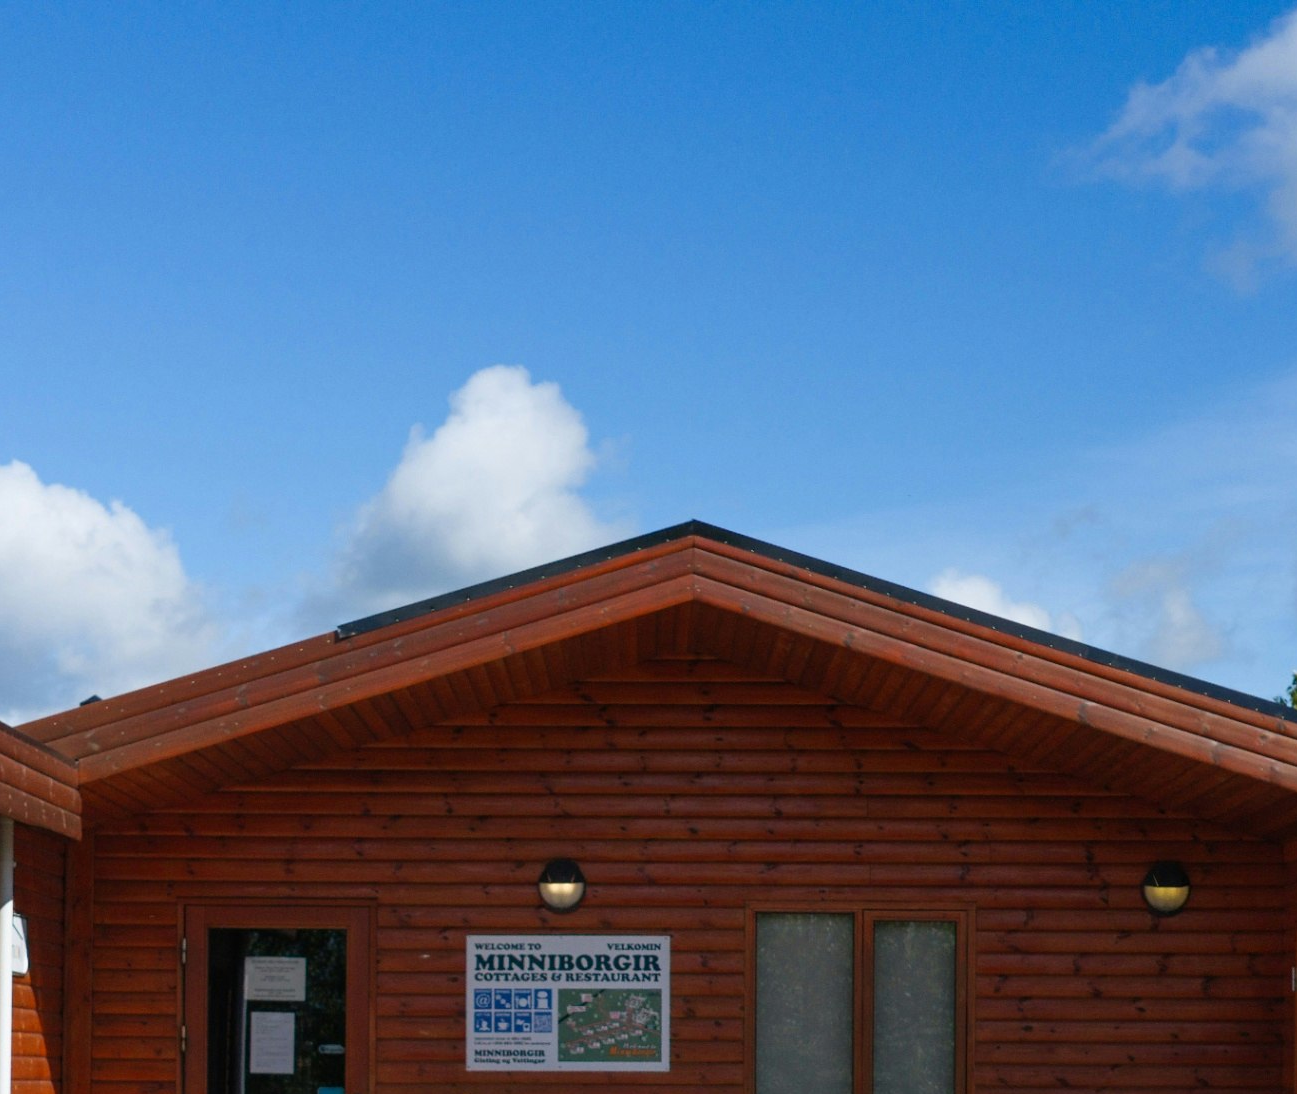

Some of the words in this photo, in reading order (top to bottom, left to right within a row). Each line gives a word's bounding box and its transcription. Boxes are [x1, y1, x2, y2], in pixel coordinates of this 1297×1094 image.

[474, 943, 525, 951] WELCOME
[527, 943, 542, 951] TO
[607, 943, 662, 951] VELKOMIN
[474, 954, 661, 971] MINNIBORGIR
[474, 973, 548, 982] COTTAGES
[551, 973, 562, 982] &
[565, 973, 661, 983] RESTAURANT
[474, 1049, 546, 1057] MINNIBORGIR
